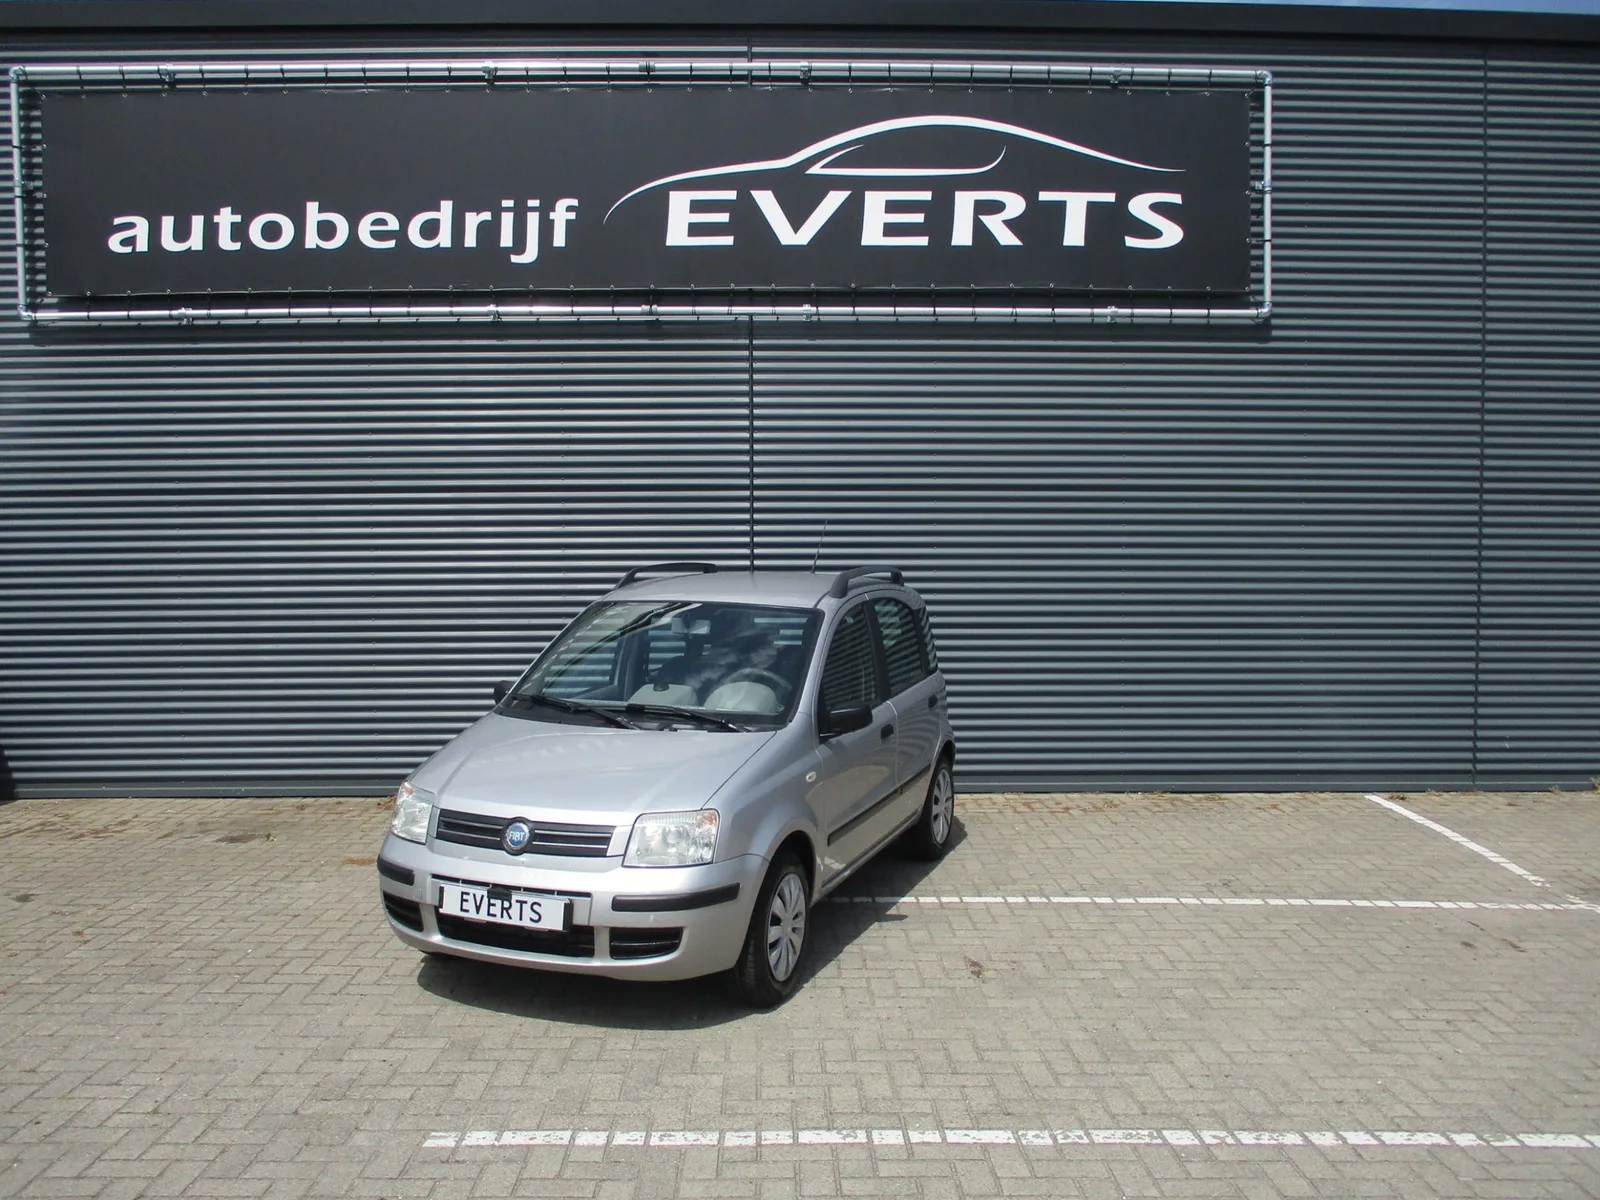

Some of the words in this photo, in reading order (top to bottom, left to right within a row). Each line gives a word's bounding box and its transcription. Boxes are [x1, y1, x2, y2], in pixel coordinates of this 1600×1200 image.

[107, 198, 579, 264] autobedrijf
[665, 189, 1184, 250] EVERTS
[509, 831, 525, 842] FIAT
[459, 891, 542, 924] EVERTS
